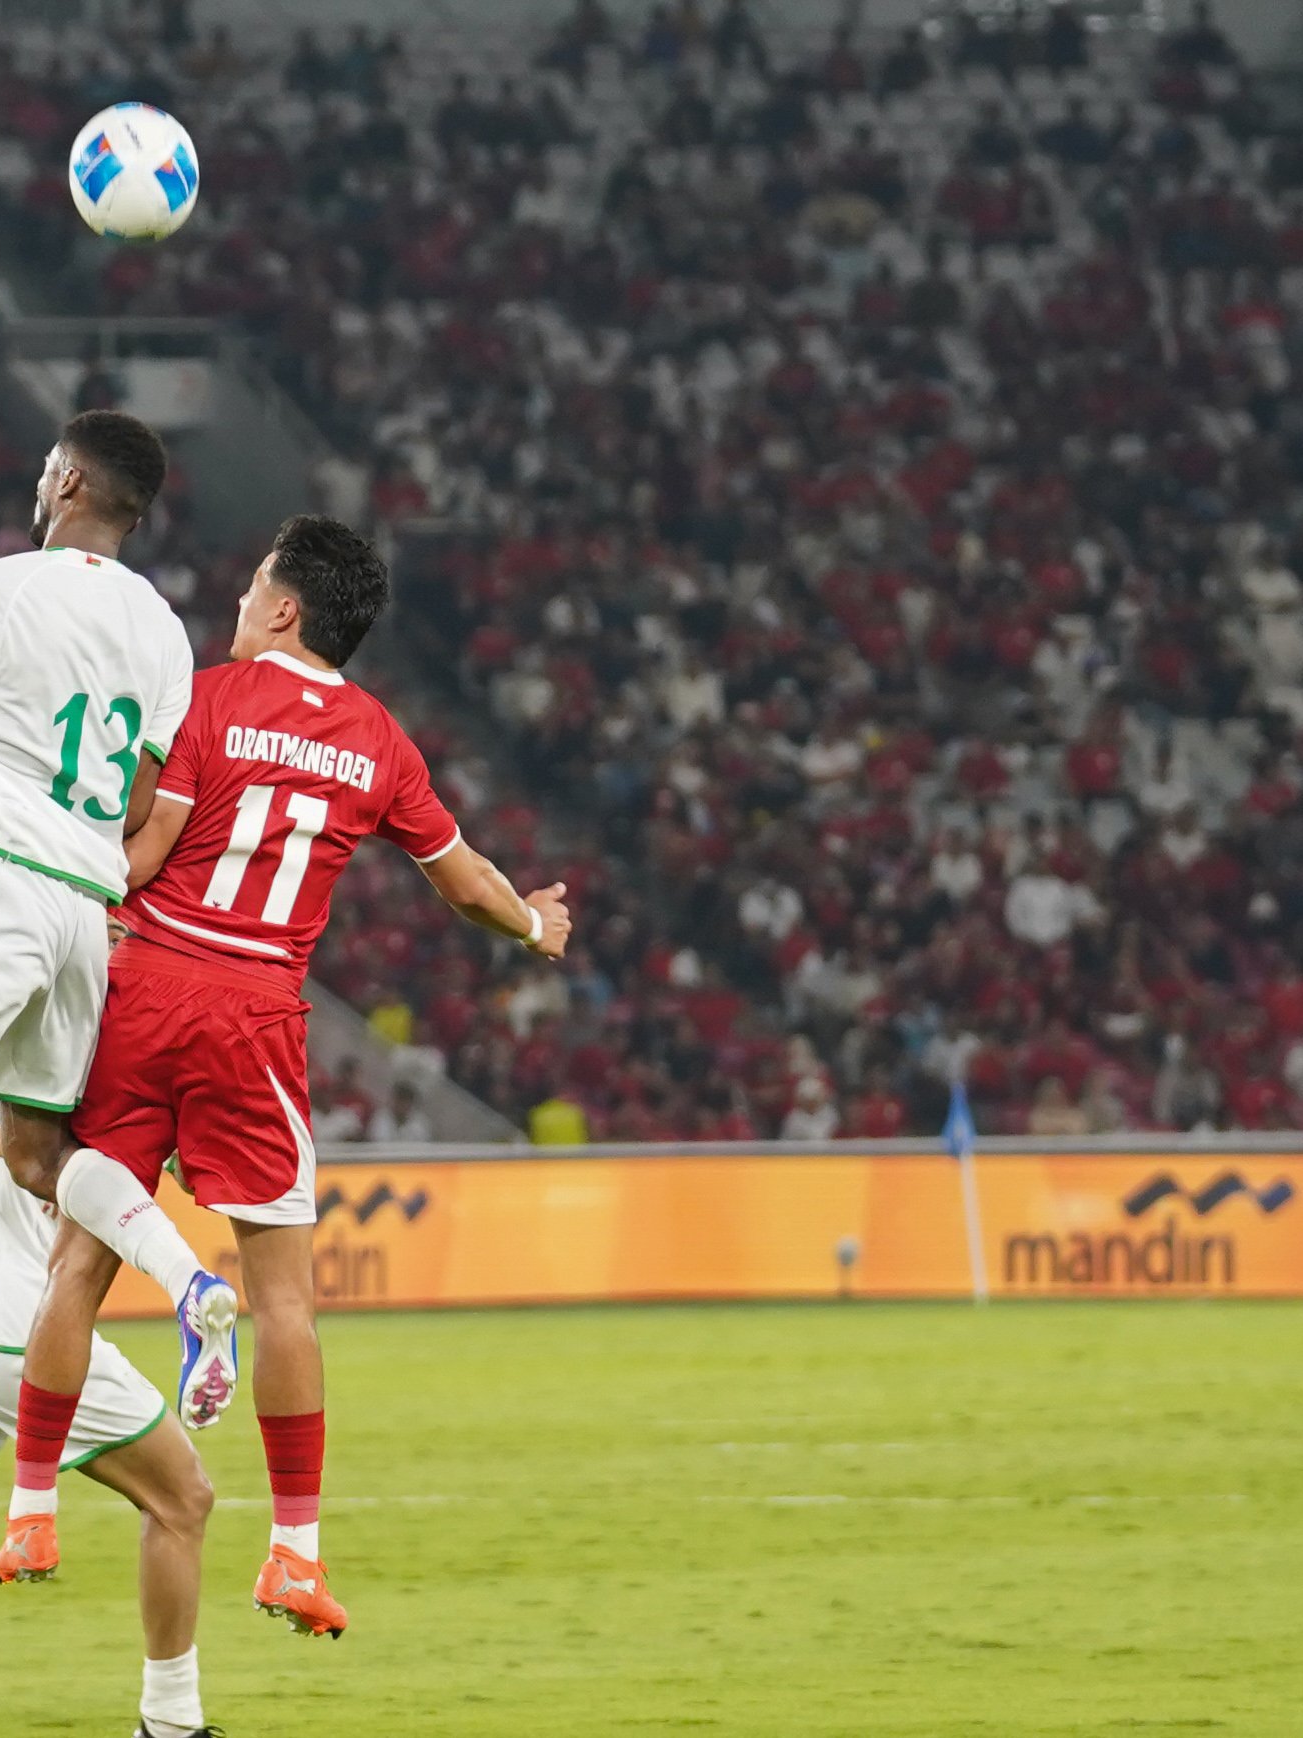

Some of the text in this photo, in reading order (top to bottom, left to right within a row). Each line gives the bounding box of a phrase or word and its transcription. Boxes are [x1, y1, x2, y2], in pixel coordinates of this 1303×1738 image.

[49, 692, 141, 821] 13
[225, 725, 376, 793] ORATMANGOEN
[201, 784, 329, 926] 11
